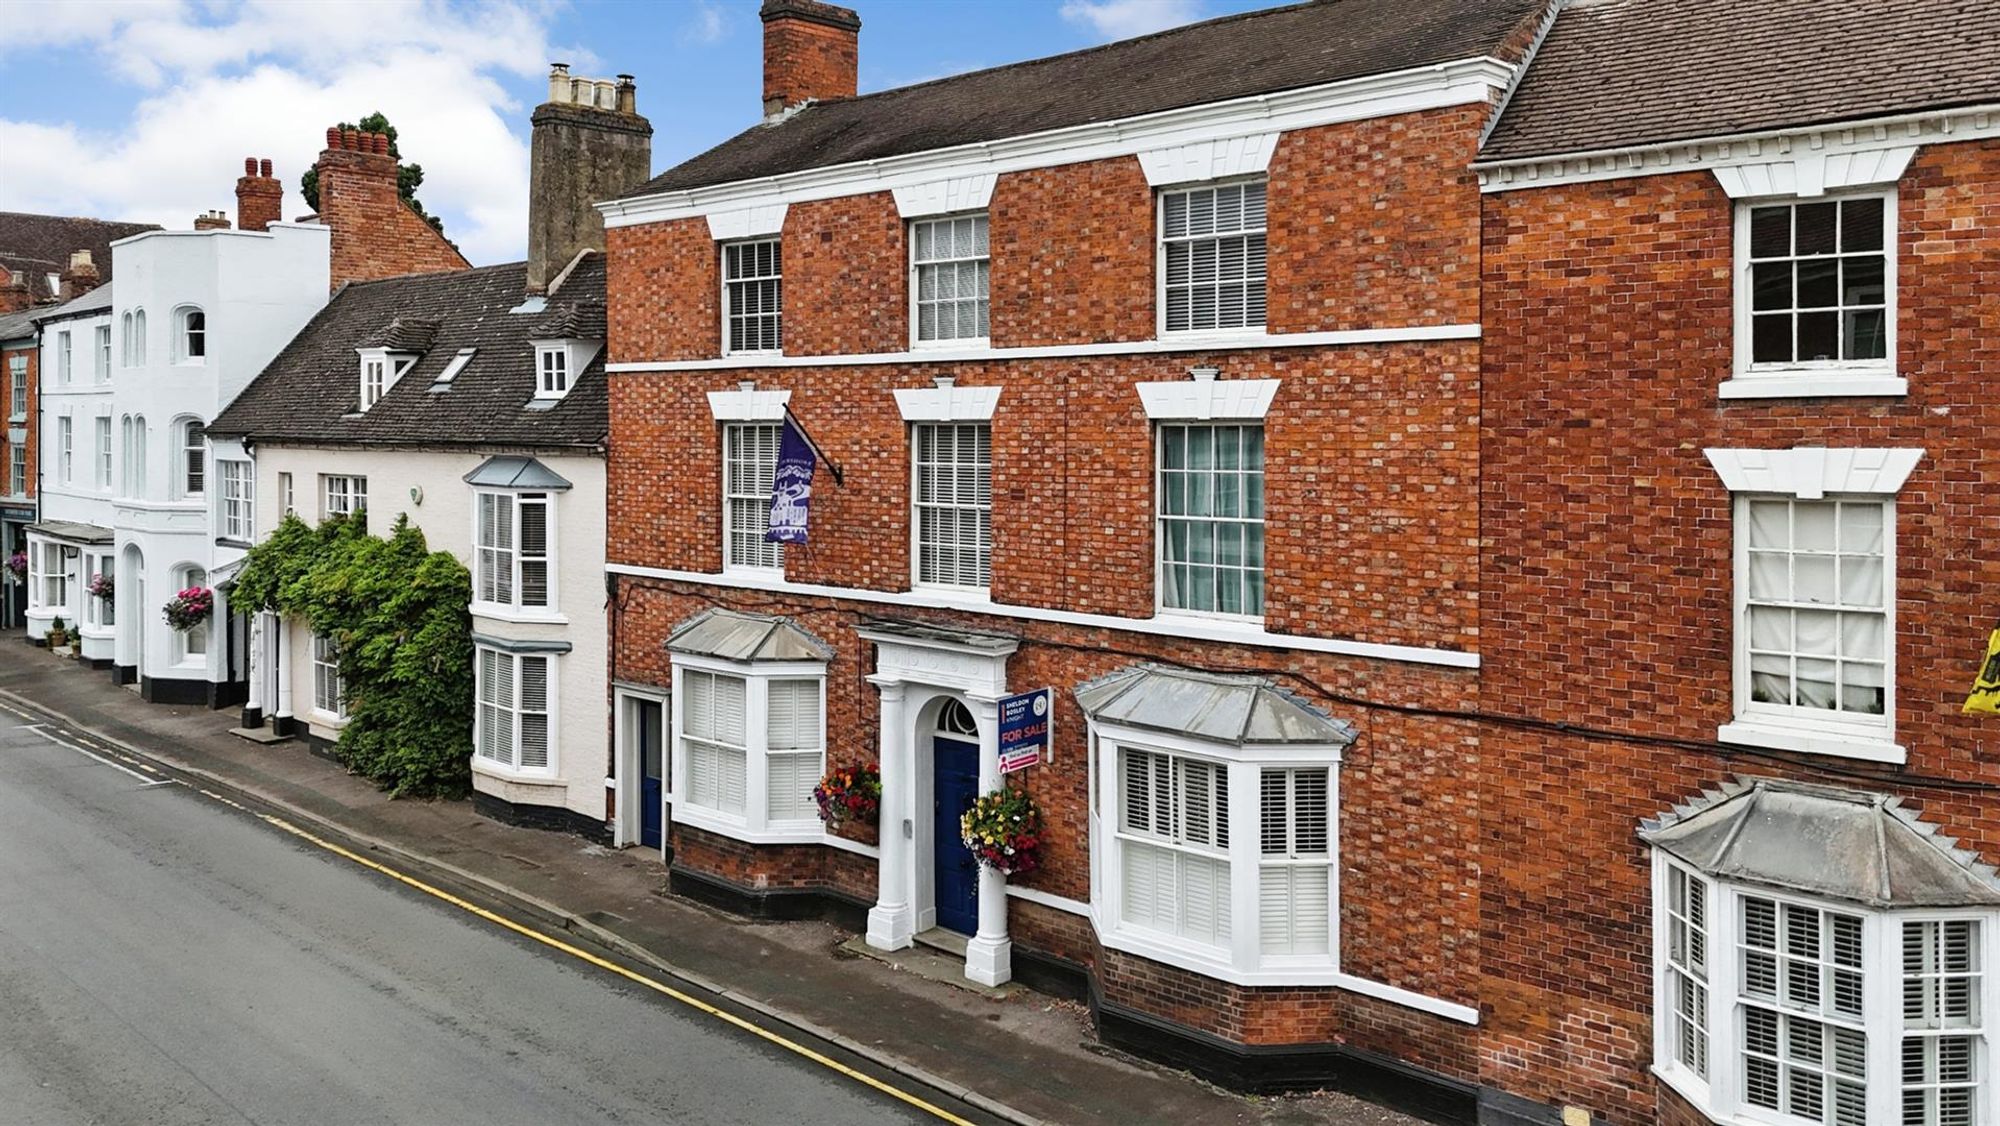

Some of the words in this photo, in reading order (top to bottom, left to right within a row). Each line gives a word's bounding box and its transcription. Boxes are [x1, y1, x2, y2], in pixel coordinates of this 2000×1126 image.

[1006, 699, 1029, 709] SHELDON
[1006, 707, 1025, 716] BOSLEY
[1006, 714, 1024, 723] KNIGHT
[1002, 729, 1023, 744] FOR
[1024, 722, 1047, 737] SALE
